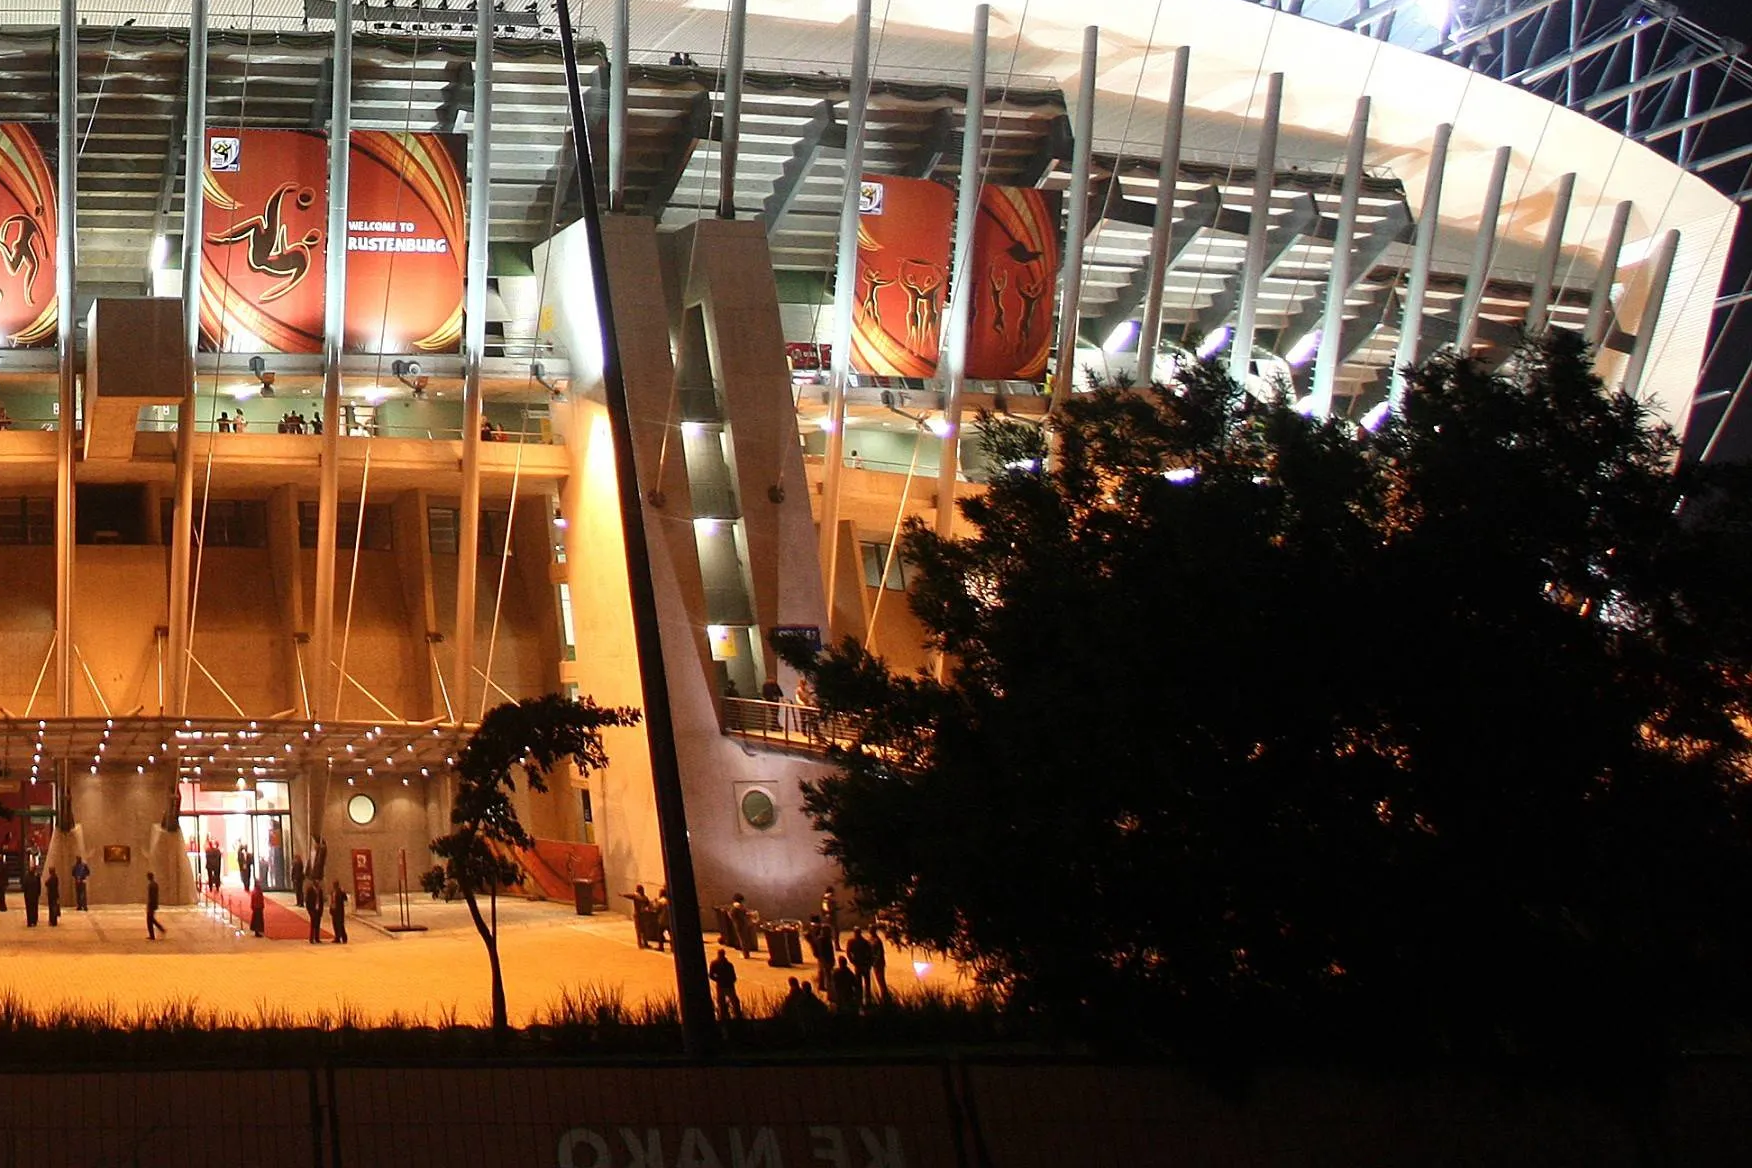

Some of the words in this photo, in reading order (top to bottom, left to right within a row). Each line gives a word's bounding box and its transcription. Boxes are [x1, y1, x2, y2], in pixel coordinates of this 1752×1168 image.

[348, 221, 396, 232] WELCOME
[399, 222, 415, 232] TO
[348, 237, 447, 253] RUSTENBURG
